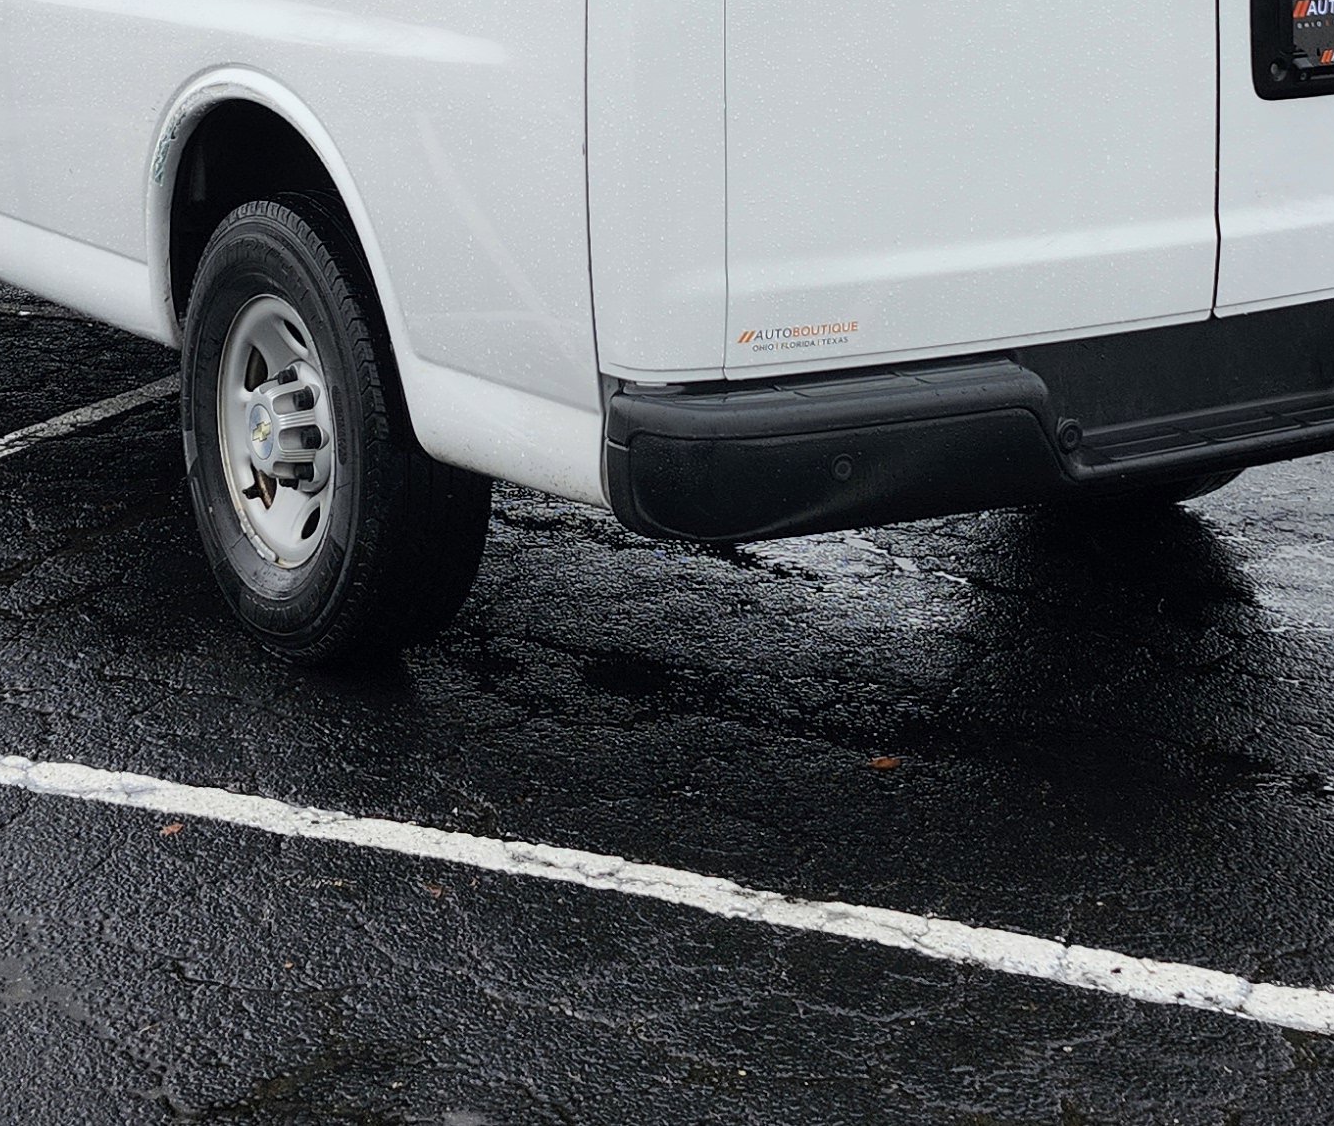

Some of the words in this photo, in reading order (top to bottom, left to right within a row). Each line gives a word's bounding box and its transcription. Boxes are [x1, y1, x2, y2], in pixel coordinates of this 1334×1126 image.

[1296, 20, 1323, 30] OHIO
[752, 343, 774, 353] OHIO
[780, 339, 816, 350] FLORIDA
[821, 336, 849, 346] TEXAS
